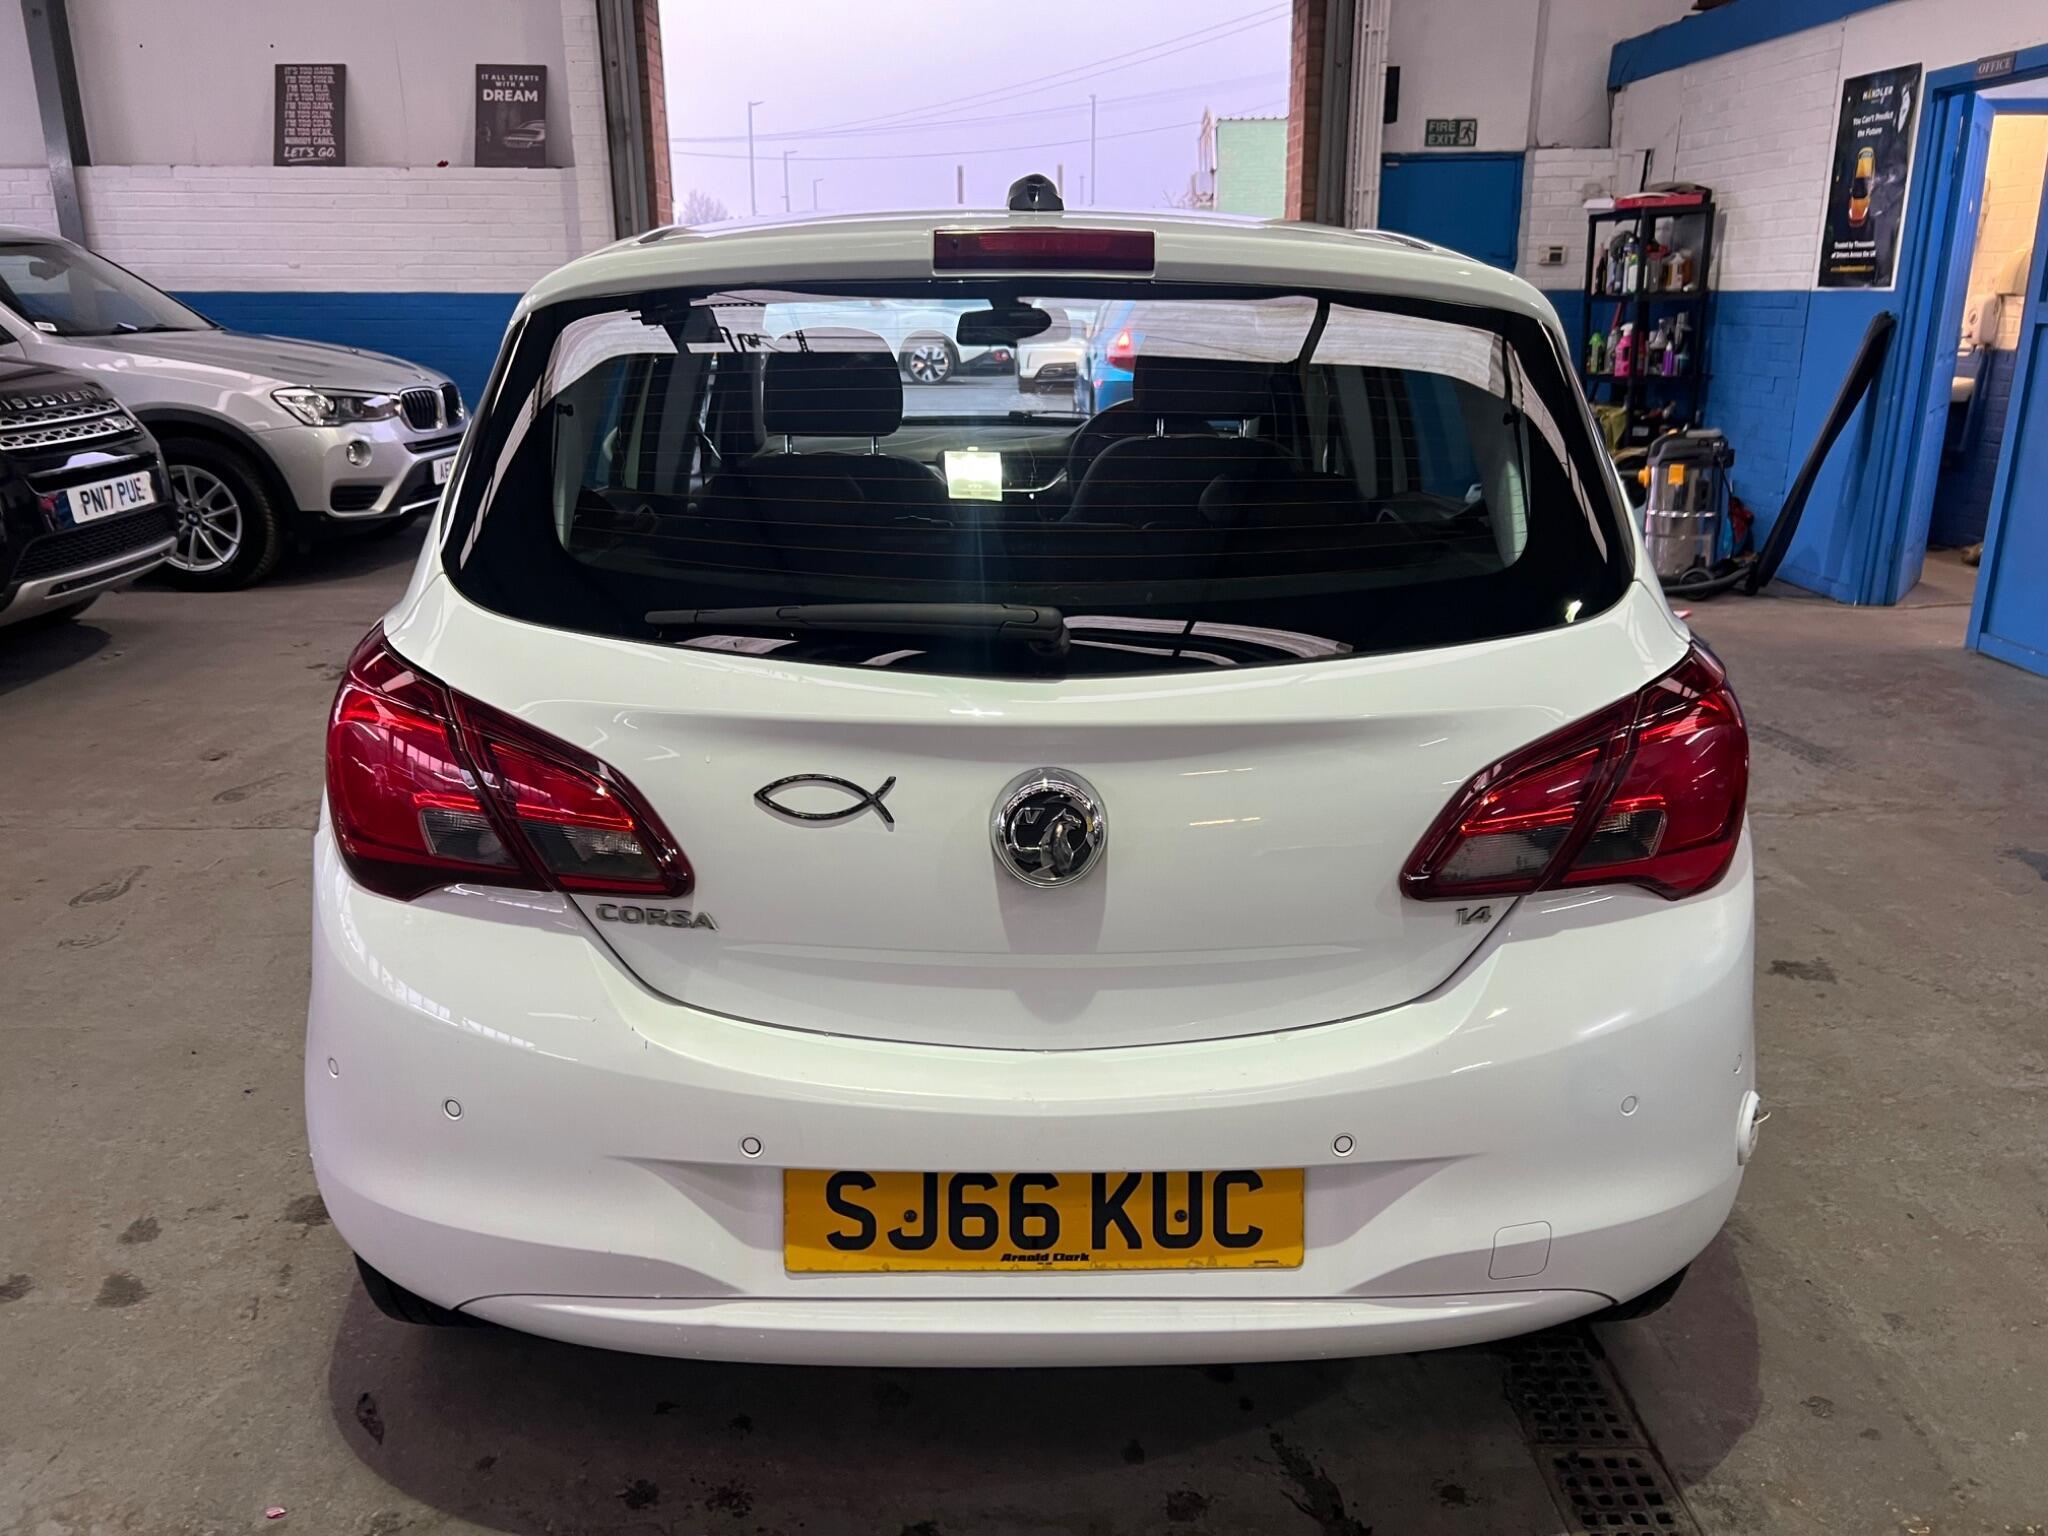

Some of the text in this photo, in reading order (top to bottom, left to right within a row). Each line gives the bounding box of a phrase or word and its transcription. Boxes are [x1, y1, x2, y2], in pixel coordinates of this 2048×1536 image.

[1979, 57, 2011, 73] OFFICE
[483, 89, 538, 102] DREAM
[1429, 121, 1457, 132] FIRE
[1428, 134, 1456, 144] EXIT
[284, 146, 316, 158] LET'S
[80, 478, 146, 516] PN17 PUE
[596, 904, 719, 931] CORSA
[826, 1170, 1264, 1250] SJ66 KUC
[1000, 1253, 1089, 1262] Arnold Clark
